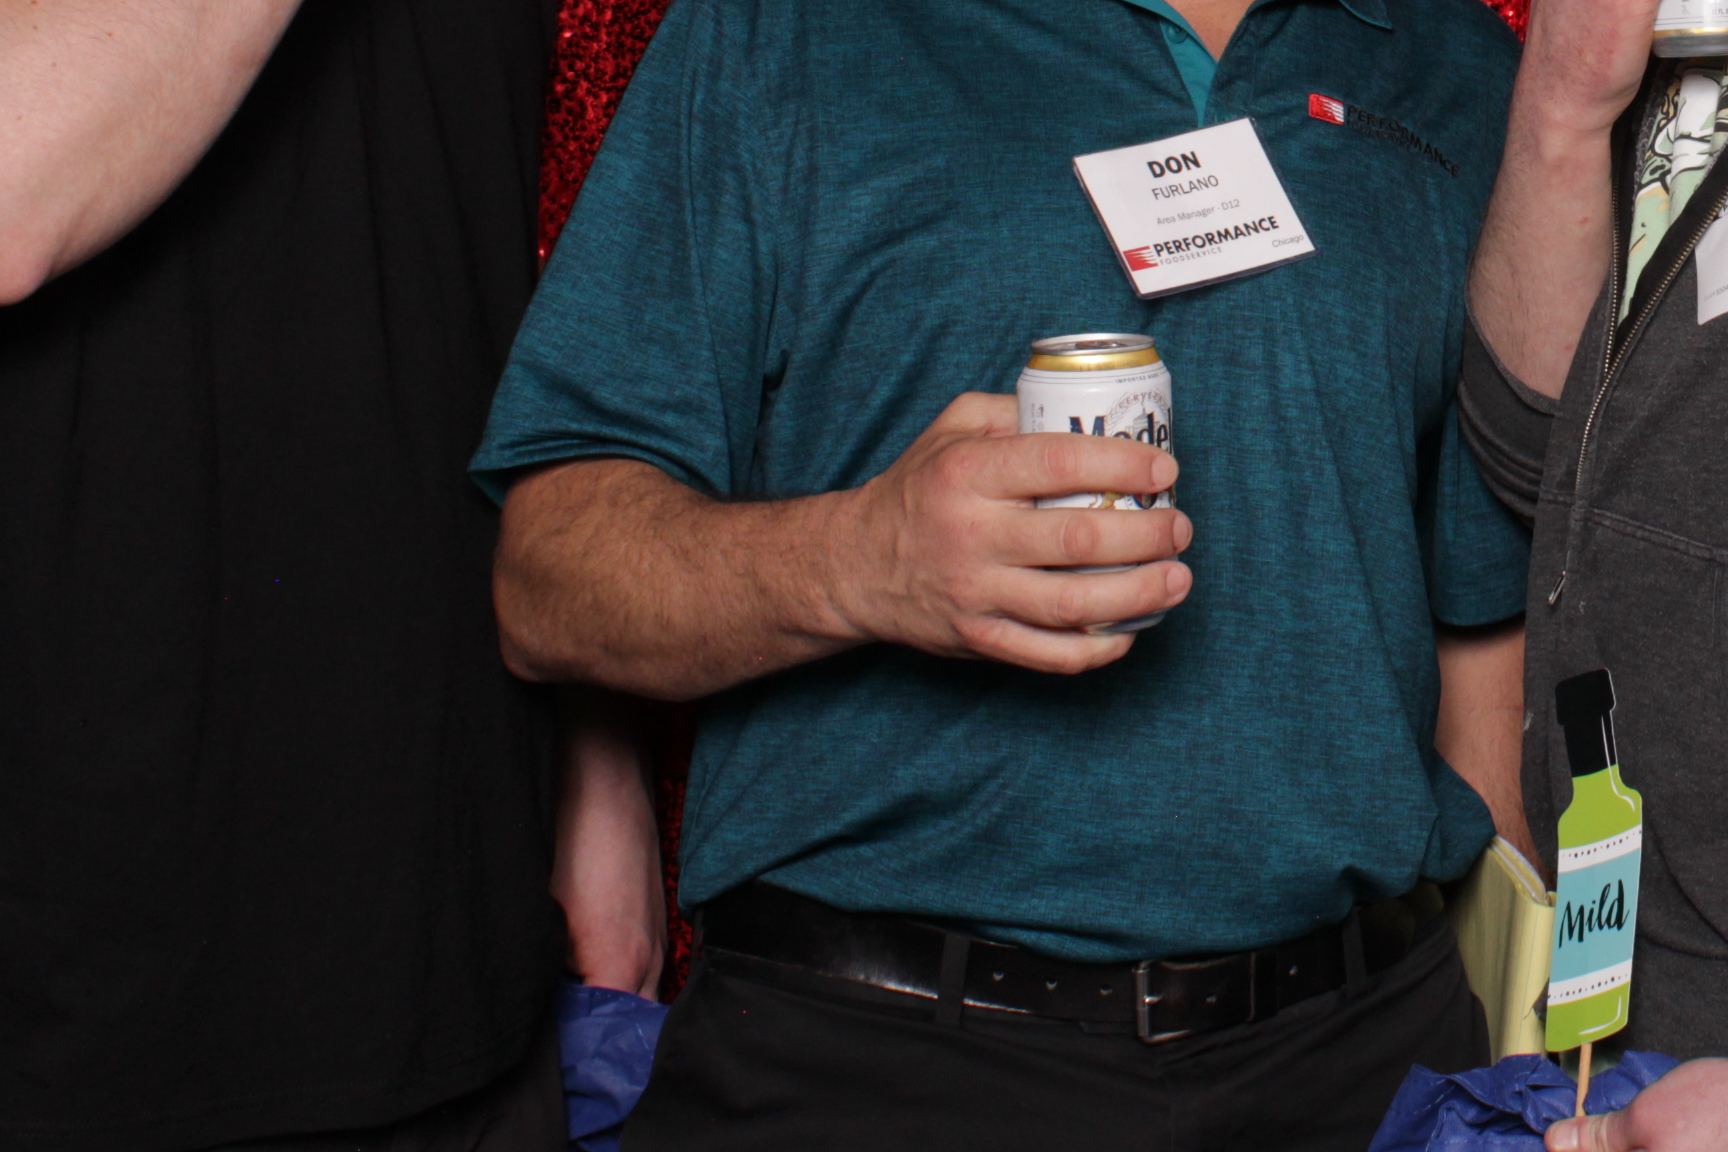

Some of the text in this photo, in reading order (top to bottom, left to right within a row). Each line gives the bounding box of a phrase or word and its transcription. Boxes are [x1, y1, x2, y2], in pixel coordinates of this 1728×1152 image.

[1347, 104, 1459, 178] PERFORMANCE
[1146, 150, 1202, 179] DON
[1151, 174, 1219, 201] FURLANO
[1156, 214, 1177, 226] Area
[1177, 205, 1215, 221] Manager
[1222, 198, 1241, 211] D12
[1153, 215, 1280, 257] PERFORMANCE
[1271, 234, 1305, 249] Chicago
[1159, 246, 1223, 266] FOODSERVICE
[1558, 878, 1630, 950] Mild
